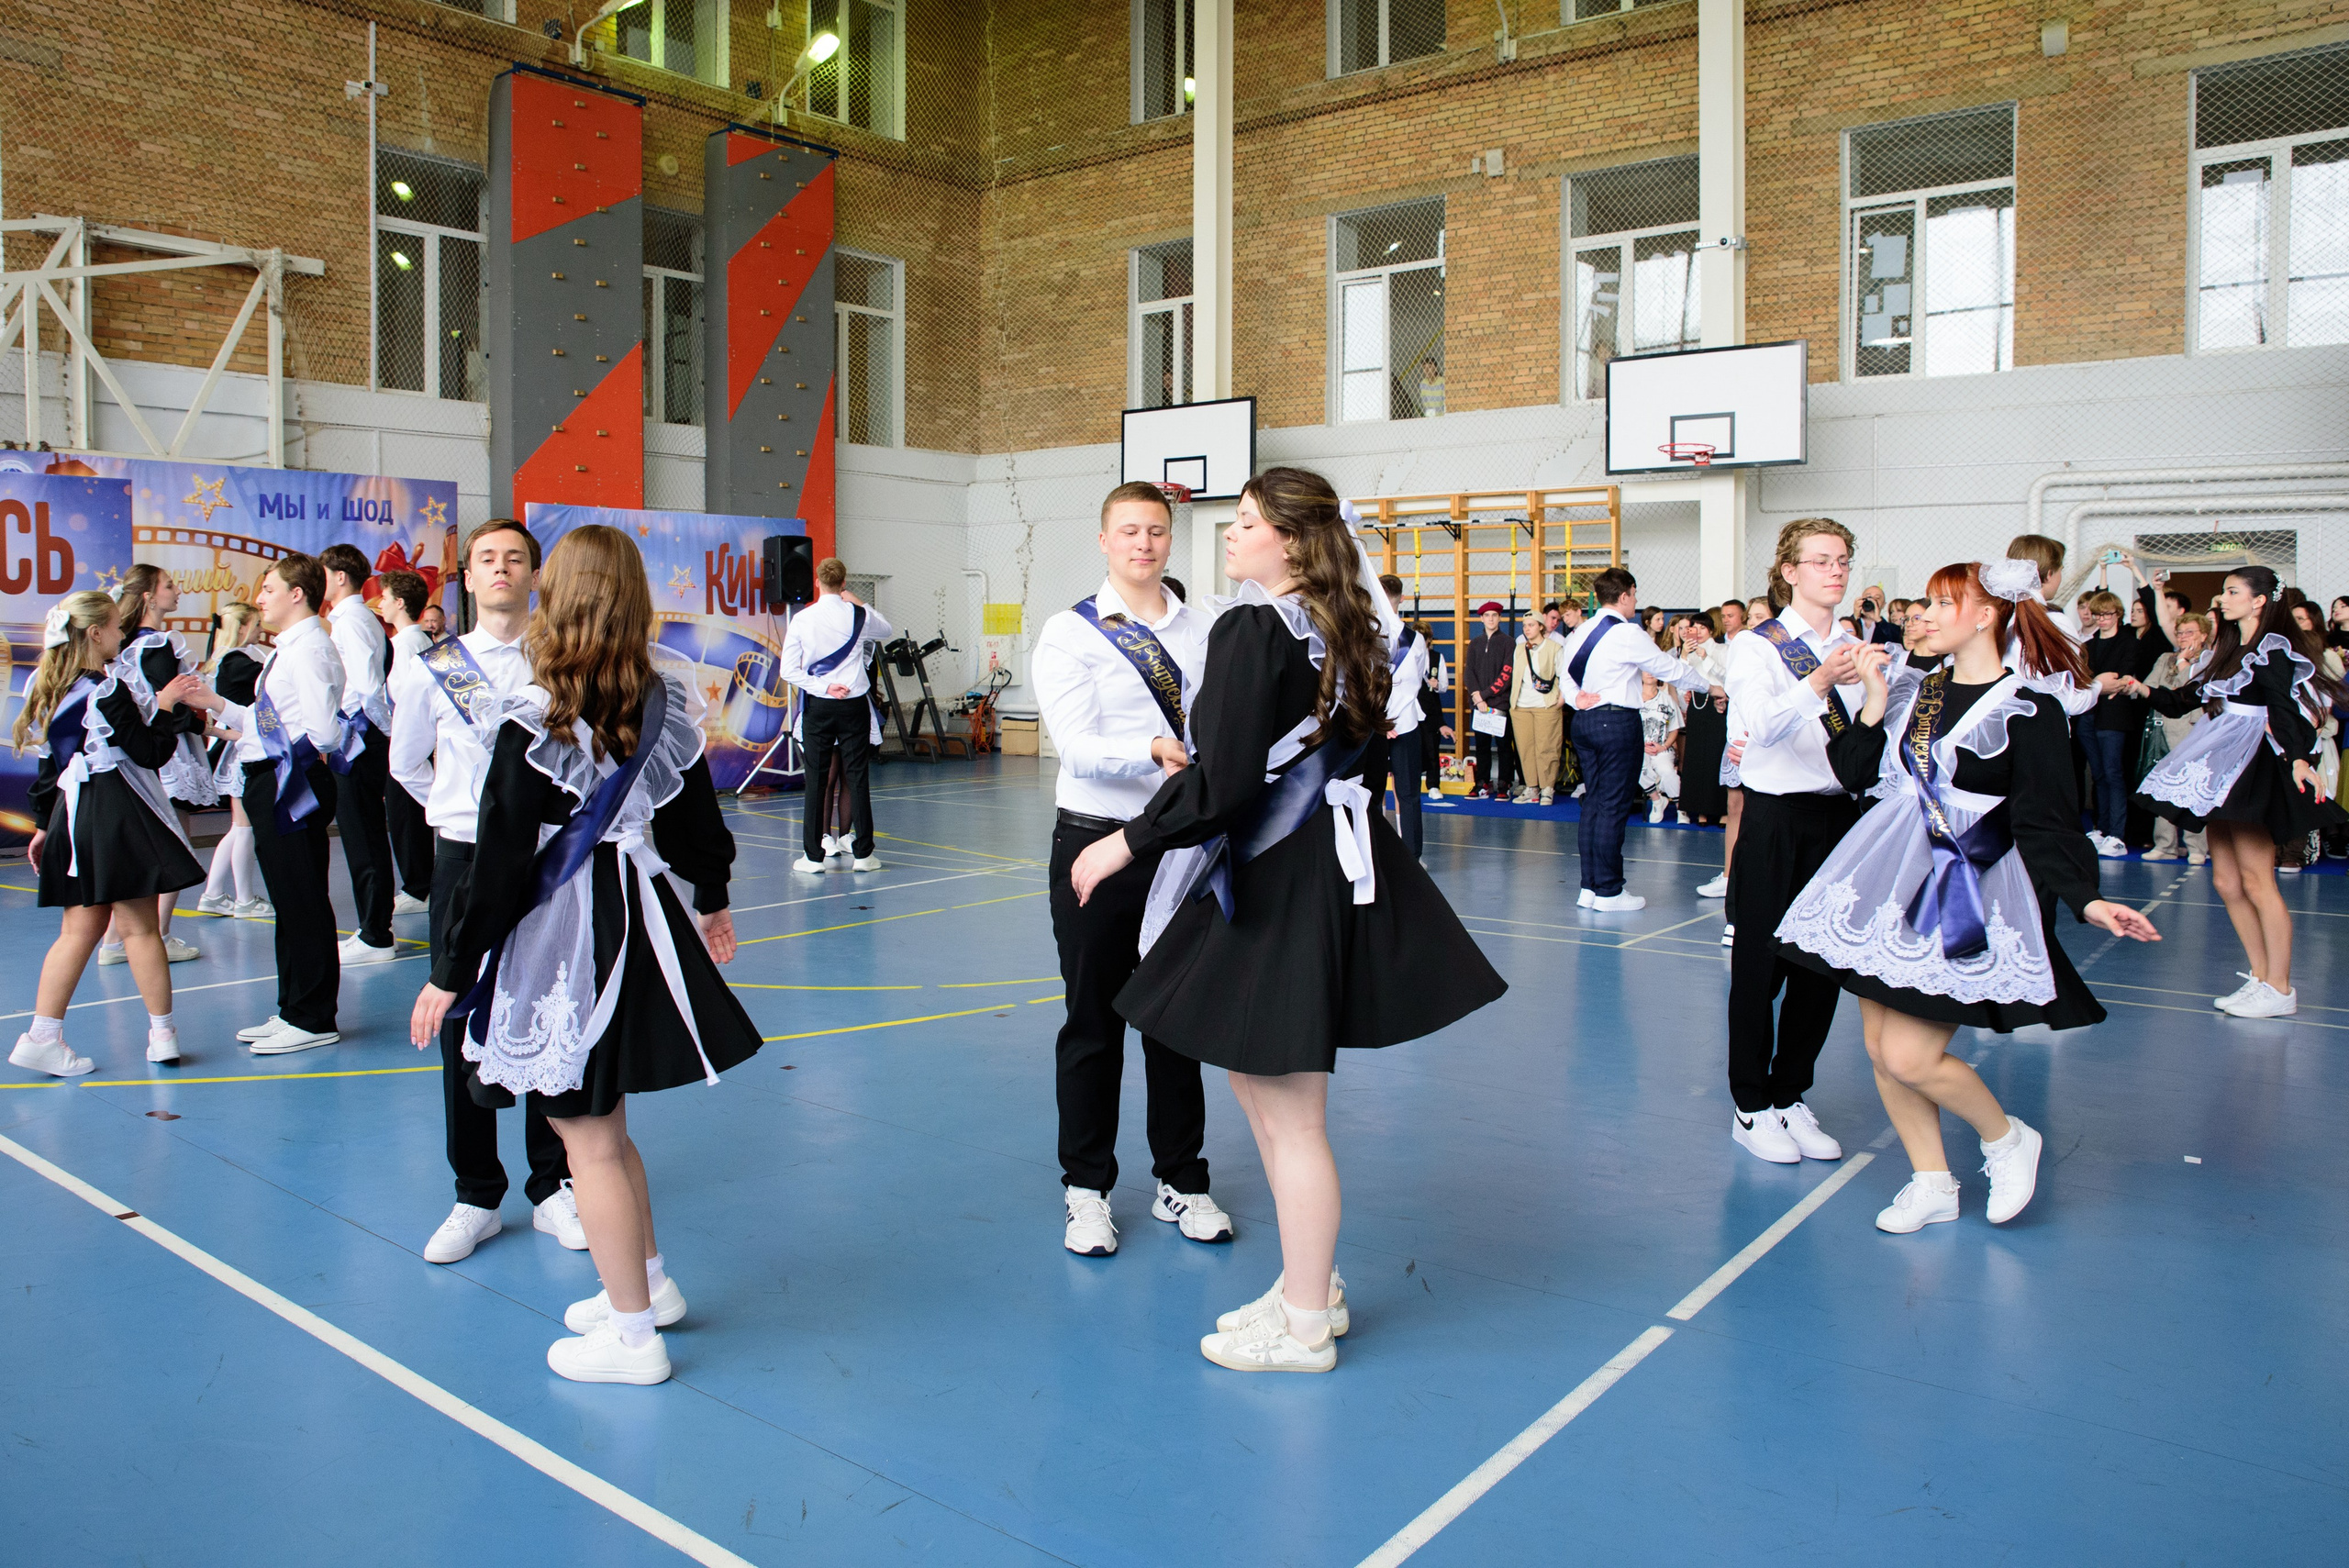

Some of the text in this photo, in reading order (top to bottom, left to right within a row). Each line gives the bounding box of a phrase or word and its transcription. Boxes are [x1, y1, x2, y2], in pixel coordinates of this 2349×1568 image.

[259, 493, 306, 520] МЫ
[341, 496, 394, 526] ШОД
[705, 542, 786, 617] КИН
[1490, 664, 1513, 695] БРАТ
